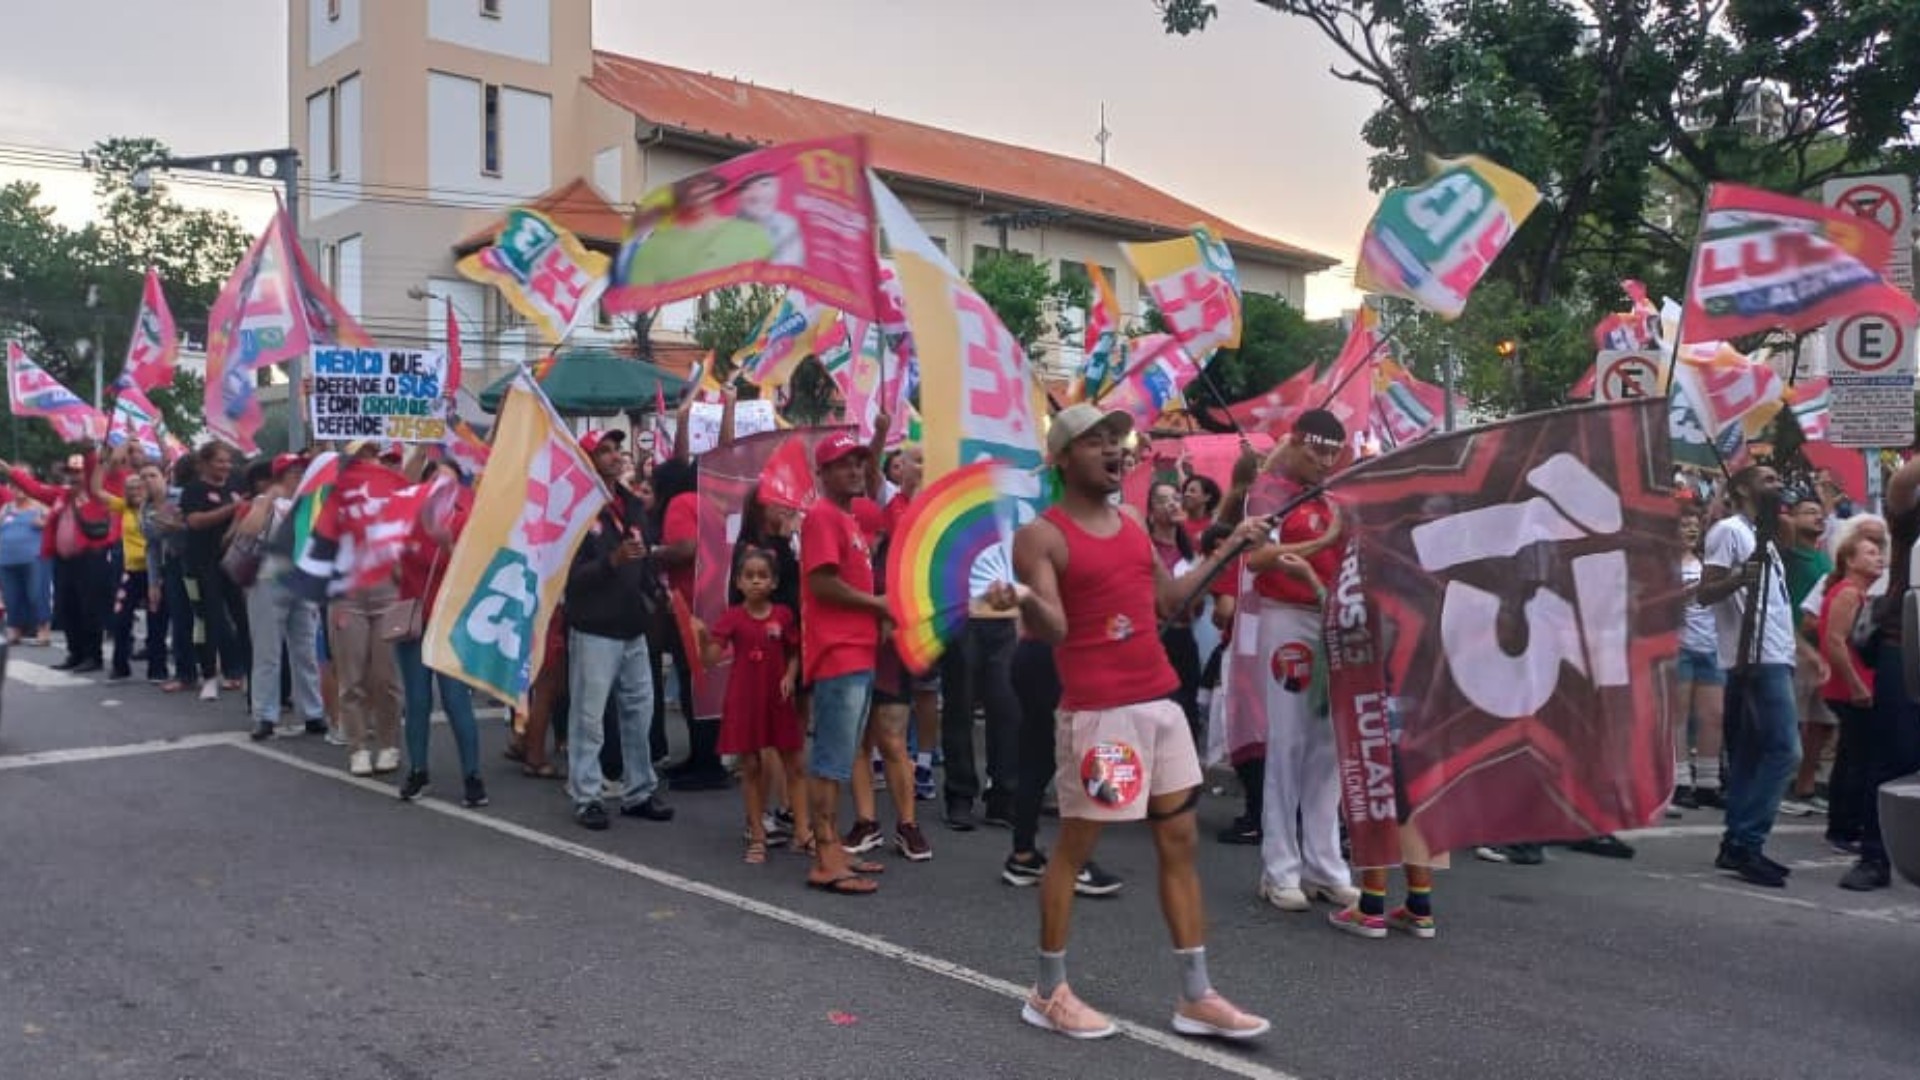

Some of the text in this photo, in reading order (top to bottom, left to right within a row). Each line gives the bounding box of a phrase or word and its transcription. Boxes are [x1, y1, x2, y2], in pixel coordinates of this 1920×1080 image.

[1859, 323, 1883, 357] E
[390, 352, 422, 376] QUE
[316, 373, 438, 399] DEFENDE O SUS
[316, 396, 325, 413] E
[317, 415, 383, 435] DEFENDE
[1353, 691, 1397, 820] LULA13
